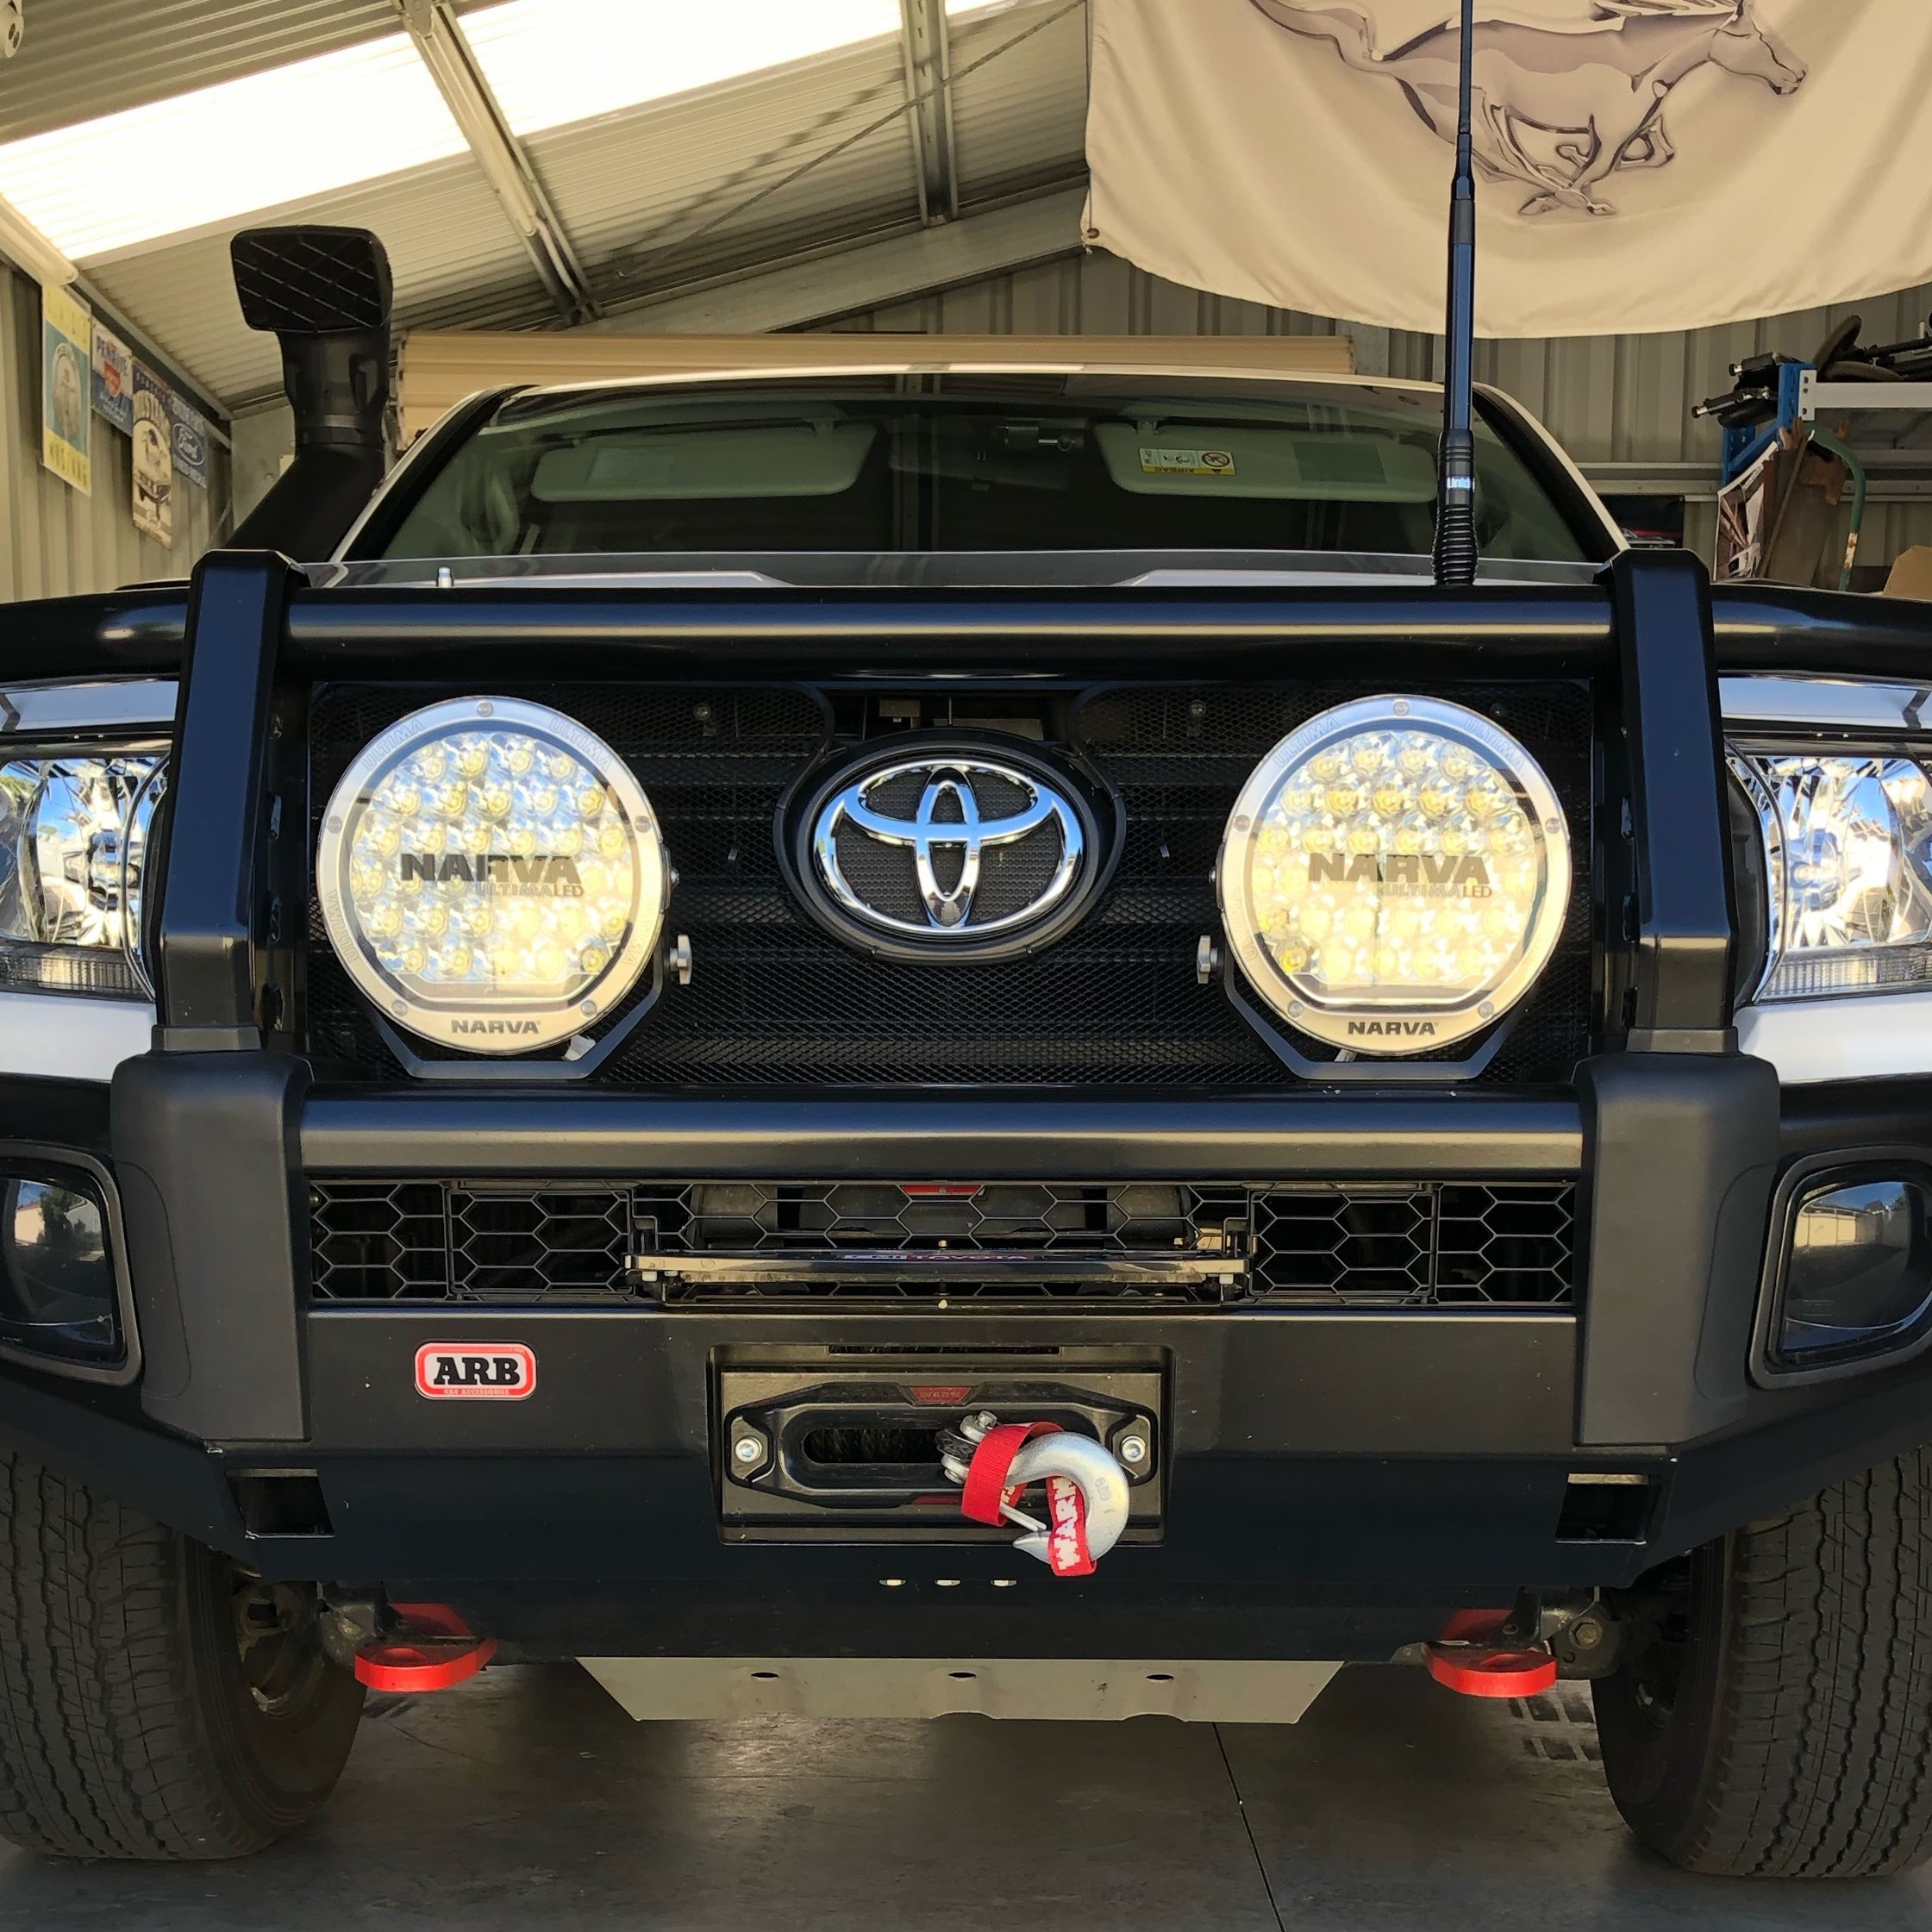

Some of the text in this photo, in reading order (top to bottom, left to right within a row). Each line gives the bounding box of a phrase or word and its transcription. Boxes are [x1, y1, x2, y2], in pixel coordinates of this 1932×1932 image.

[401, 853, 581, 884] NARVA
[1310, 853, 1490, 885] NARVA
[451, 1019, 539, 1035] NARVA
[1347, 1021, 1436, 1036] NARVA
[434, 1357, 520, 1385] ARB
[1052, 1477, 1081, 1570] WARN
